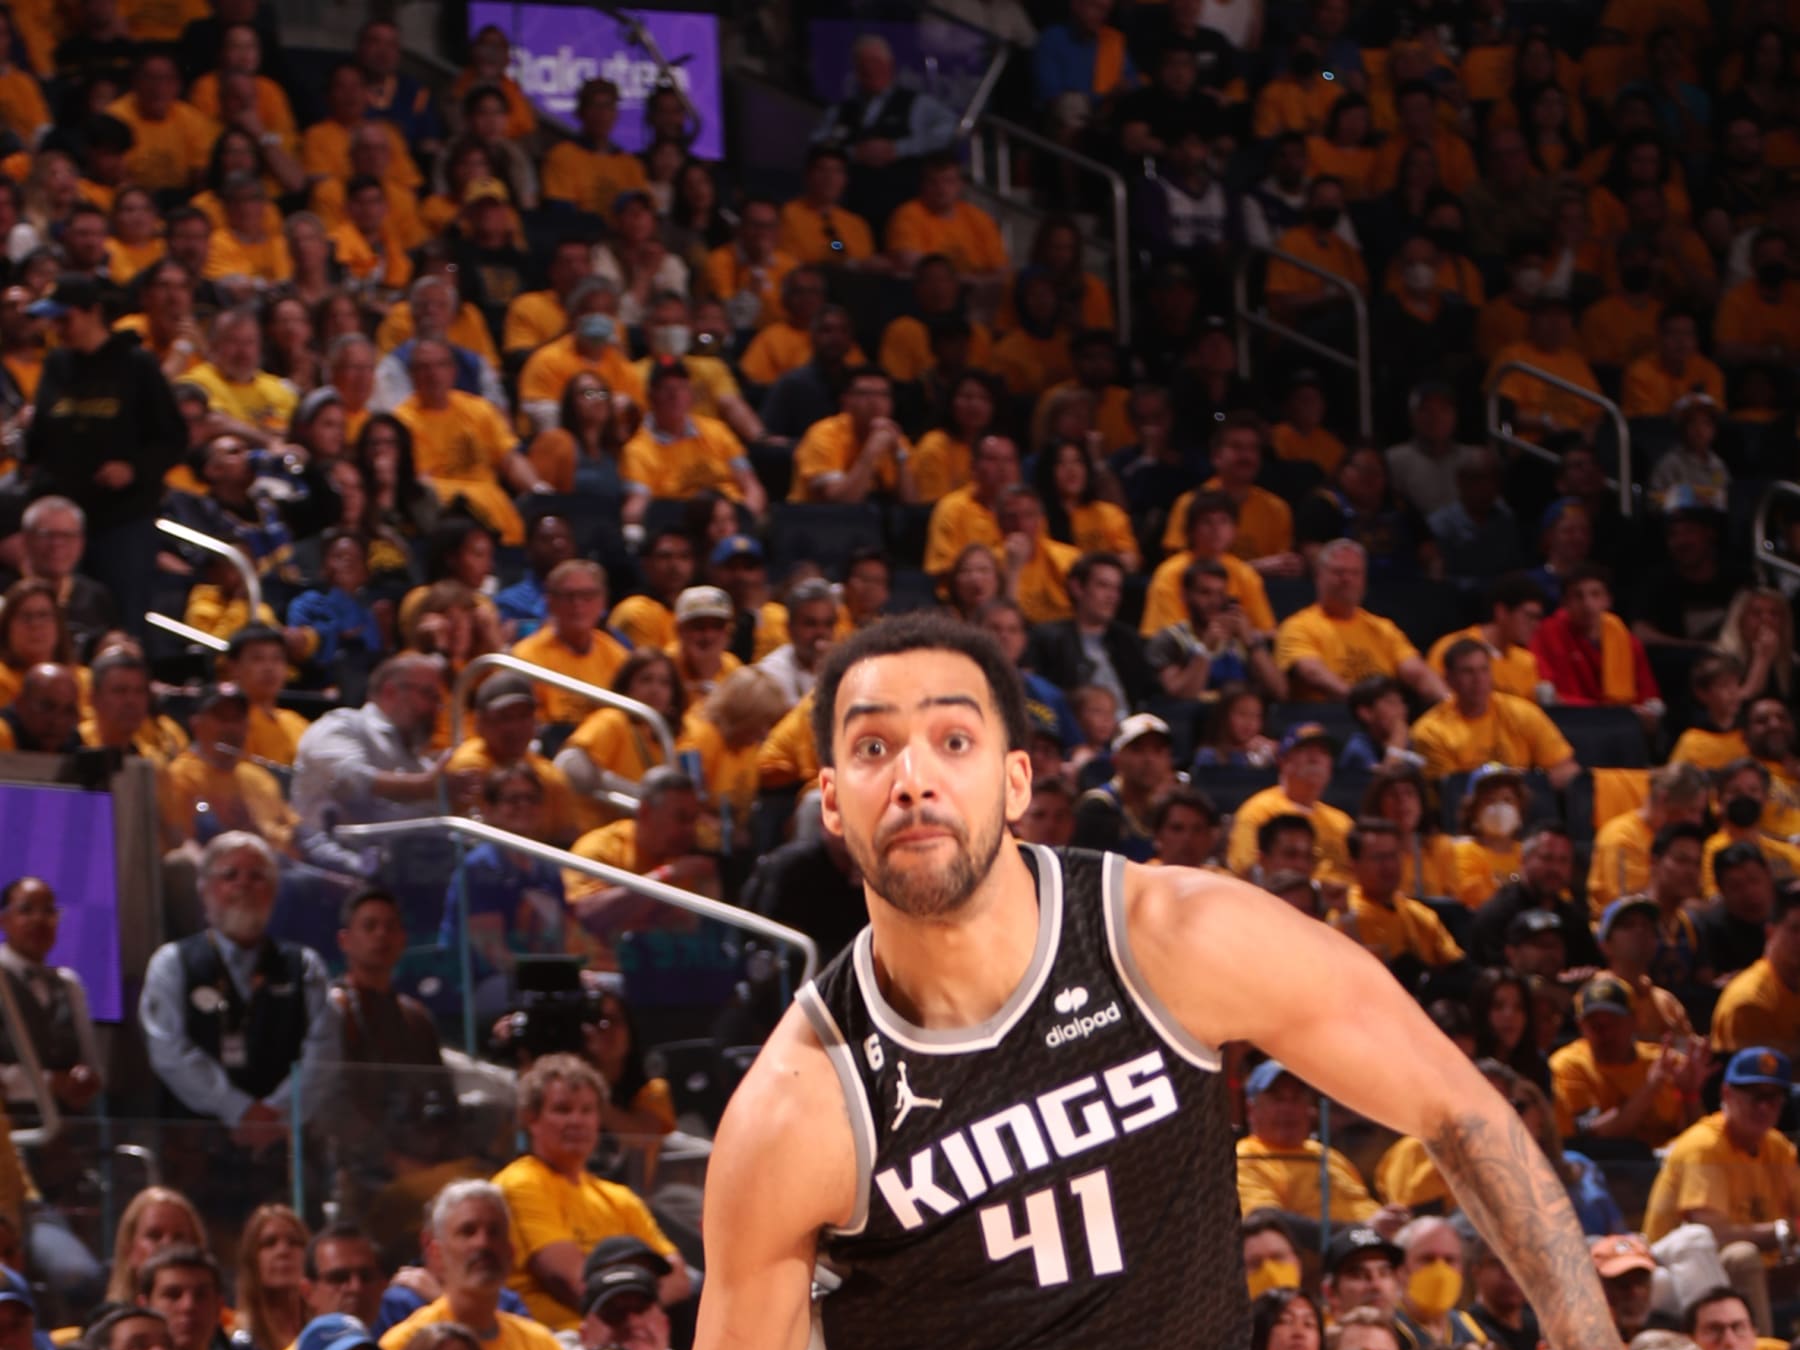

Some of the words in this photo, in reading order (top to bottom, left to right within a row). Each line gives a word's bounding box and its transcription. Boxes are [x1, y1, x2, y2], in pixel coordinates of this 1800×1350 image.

[863, 1033, 885, 1072] 6
[1045, 1001, 1121, 1048] dialpad
[875, 1050, 1178, 1230] KINGS
[980, 1169, 1124, 1287] 41
